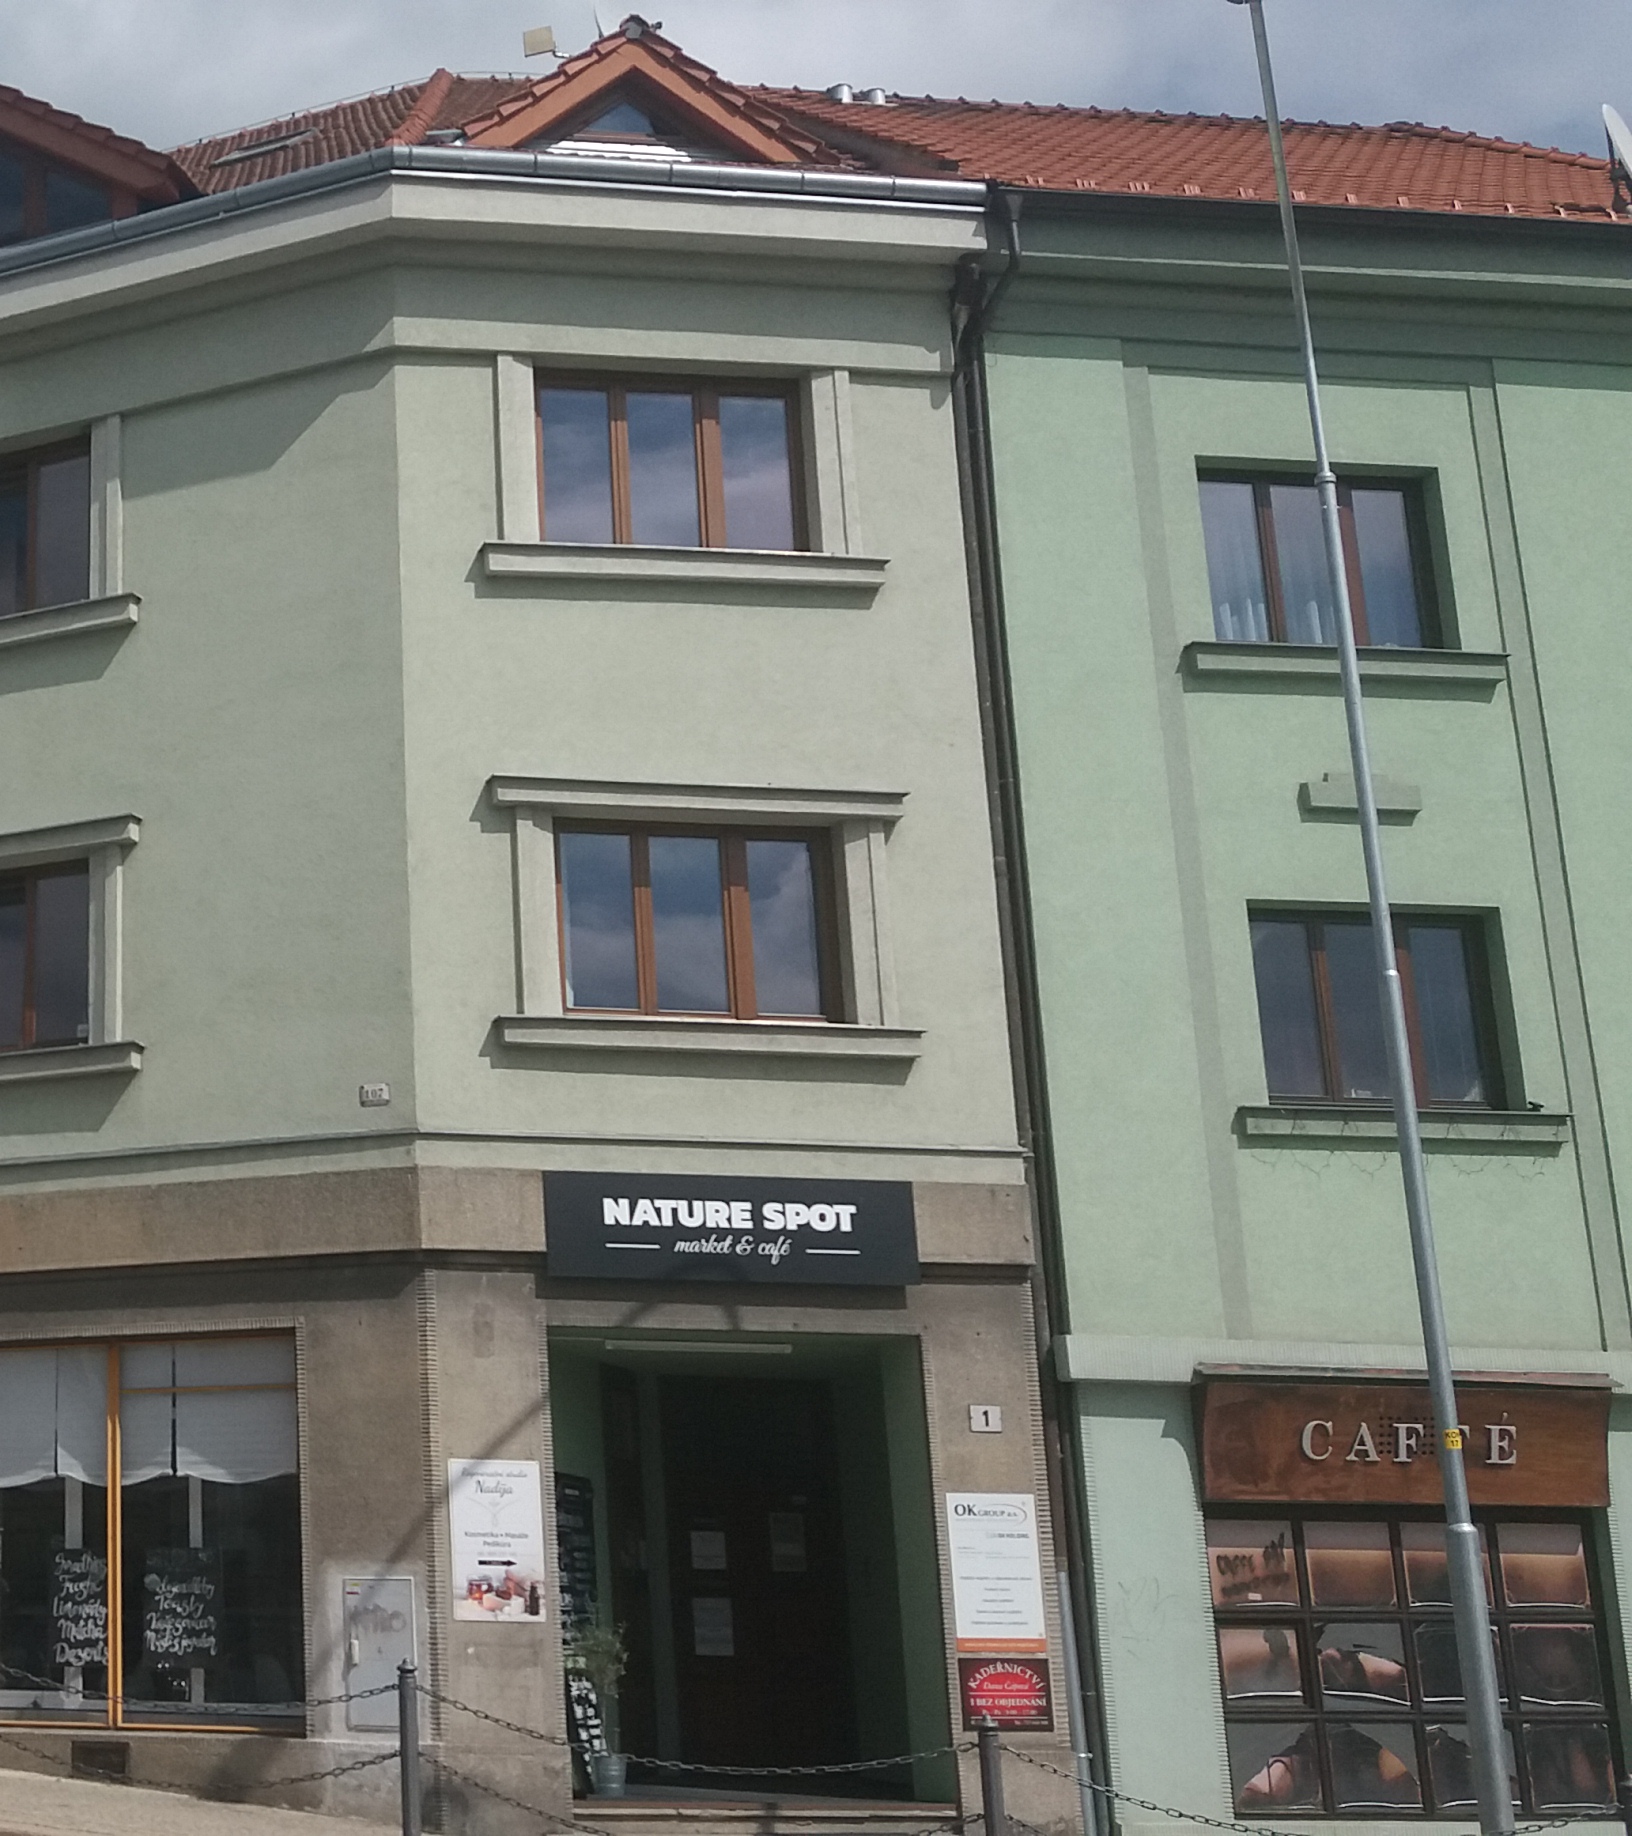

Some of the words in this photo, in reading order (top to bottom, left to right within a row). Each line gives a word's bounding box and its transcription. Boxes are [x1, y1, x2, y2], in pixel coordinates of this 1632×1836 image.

[602, 1197, 754, 1229] NATURE
[762, 1202, 858, 1232] SPOT
[674, 1234, 733, 1254] market
[735, 1235, 755, 1256] &
[757, 1235, 794, 1265] café
[982, 1409, 990, 1428] 1
[1301, 1412, 1518, 1466] CAFÉ
[954, 1503, 978, 1518] OK
[978, 1509, 1006, 1518] GROUP
[968, 1661, 1046, 1690] KADEŘNICTVÍ
[976, 1698, 994, 1706] BEZ
